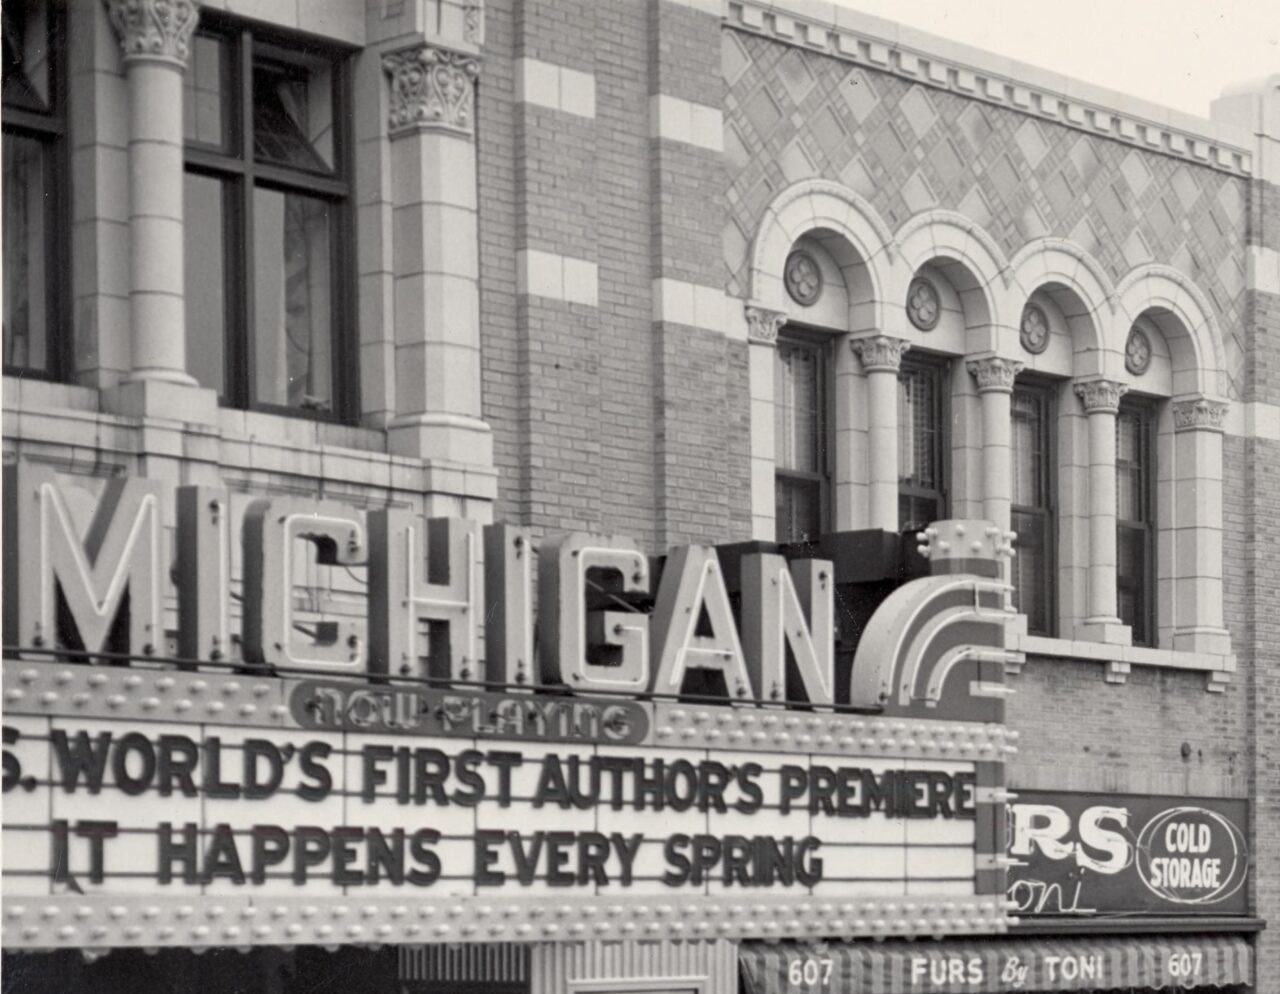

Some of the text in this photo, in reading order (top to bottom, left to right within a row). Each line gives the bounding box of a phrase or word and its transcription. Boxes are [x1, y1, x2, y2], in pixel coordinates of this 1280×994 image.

[6, 458, 835, 712] MICHIGAN
[361, 744, 523, 808] FIRST
[779, 764, 977, 820] PREMIERE
[157, 821, 443, 887] HAPPENS
[474, 828, 644, 888] EVERY
[663, 834, 823, 888] SPRING
[1006, 804, 1134, 875] RS
[1165, 822, 1212, 854] COLD
[1006, 866, 1098, 913] oni
[1150, 856, 1222, 890] STORAGE
[788, 958, 834, 986] 607
[911, 955, 1103, 988] FURS By TONI
[1168, 952, 1203, 977] 607
